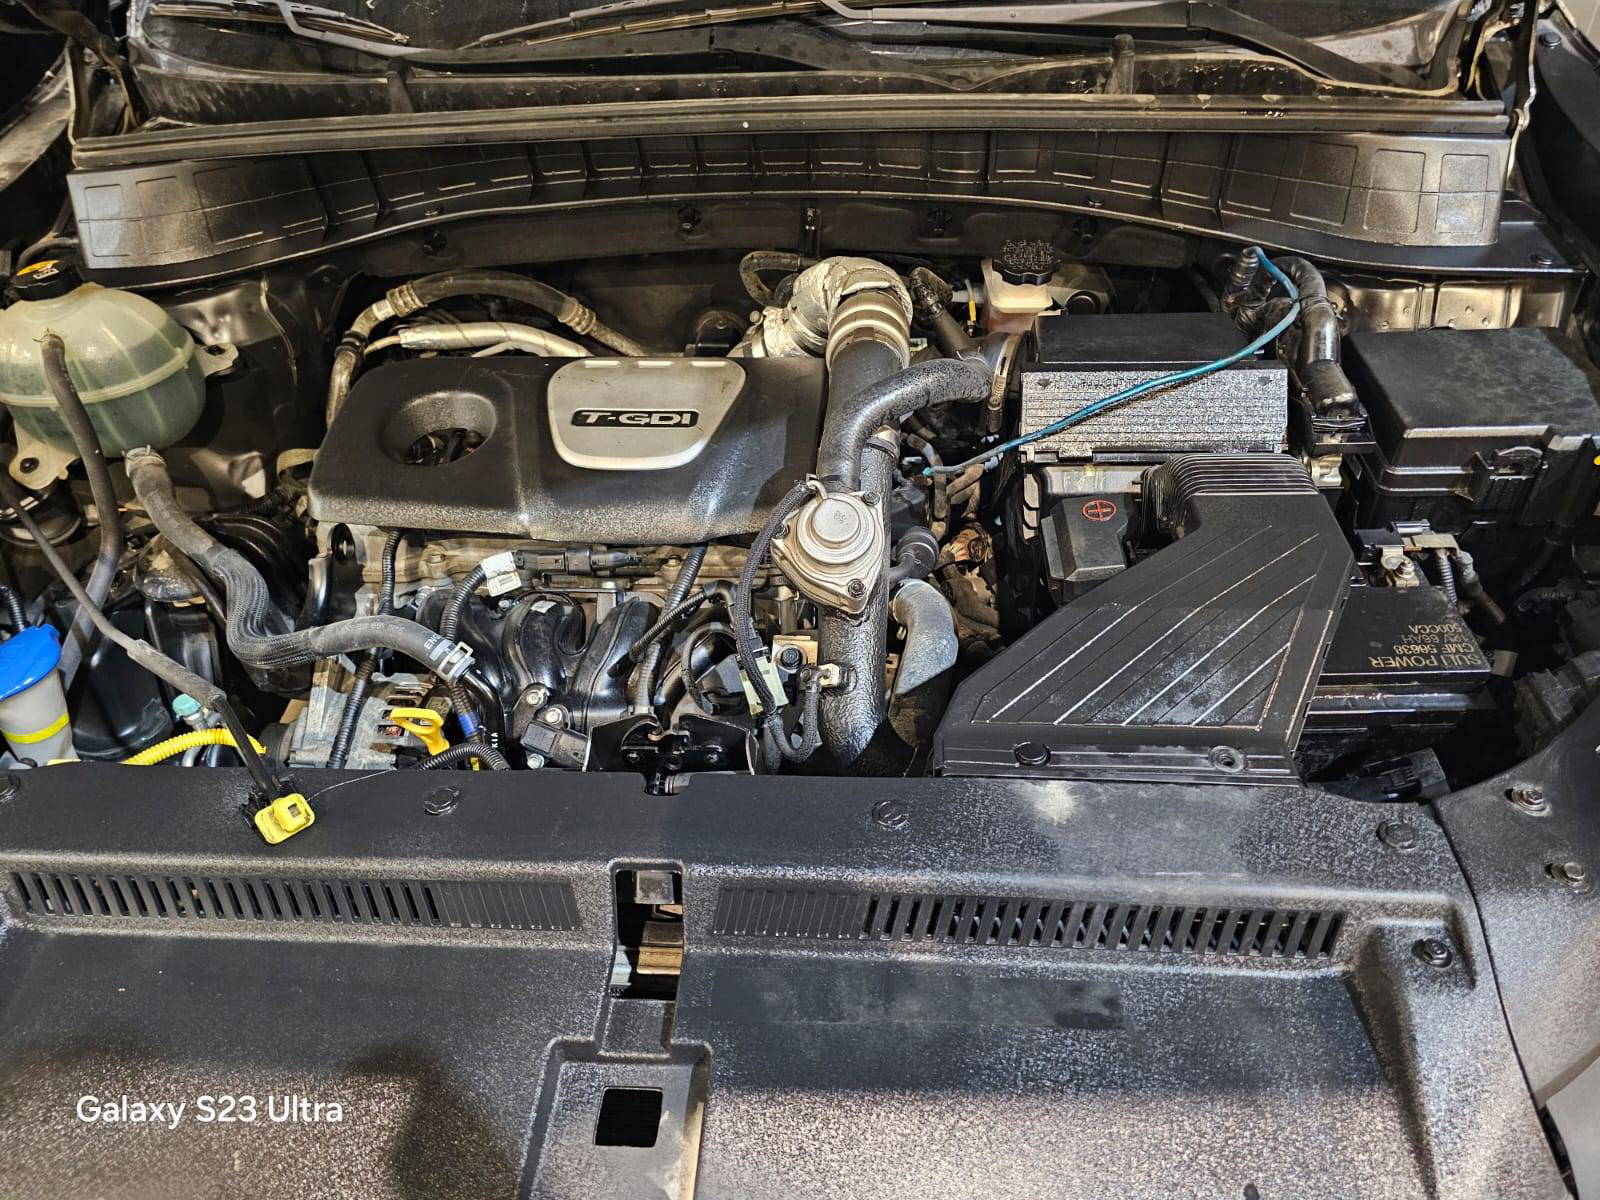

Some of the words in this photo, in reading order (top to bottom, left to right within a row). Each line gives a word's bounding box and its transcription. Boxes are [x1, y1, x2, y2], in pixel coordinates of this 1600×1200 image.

[581, 411, 691, 426] T-GDI
[1408, 624, 1463, 634] 500CCA
[1401, 634, 1438, 644] 66AH
[1393, 644, 1437, 654] 56638
[1442, 643, 1475, 654] CMF
[1368, 655, 1438, 668] POWER
[1443, 655, 1482, 667] SULI
[490, 732, 499, 749] KIA
